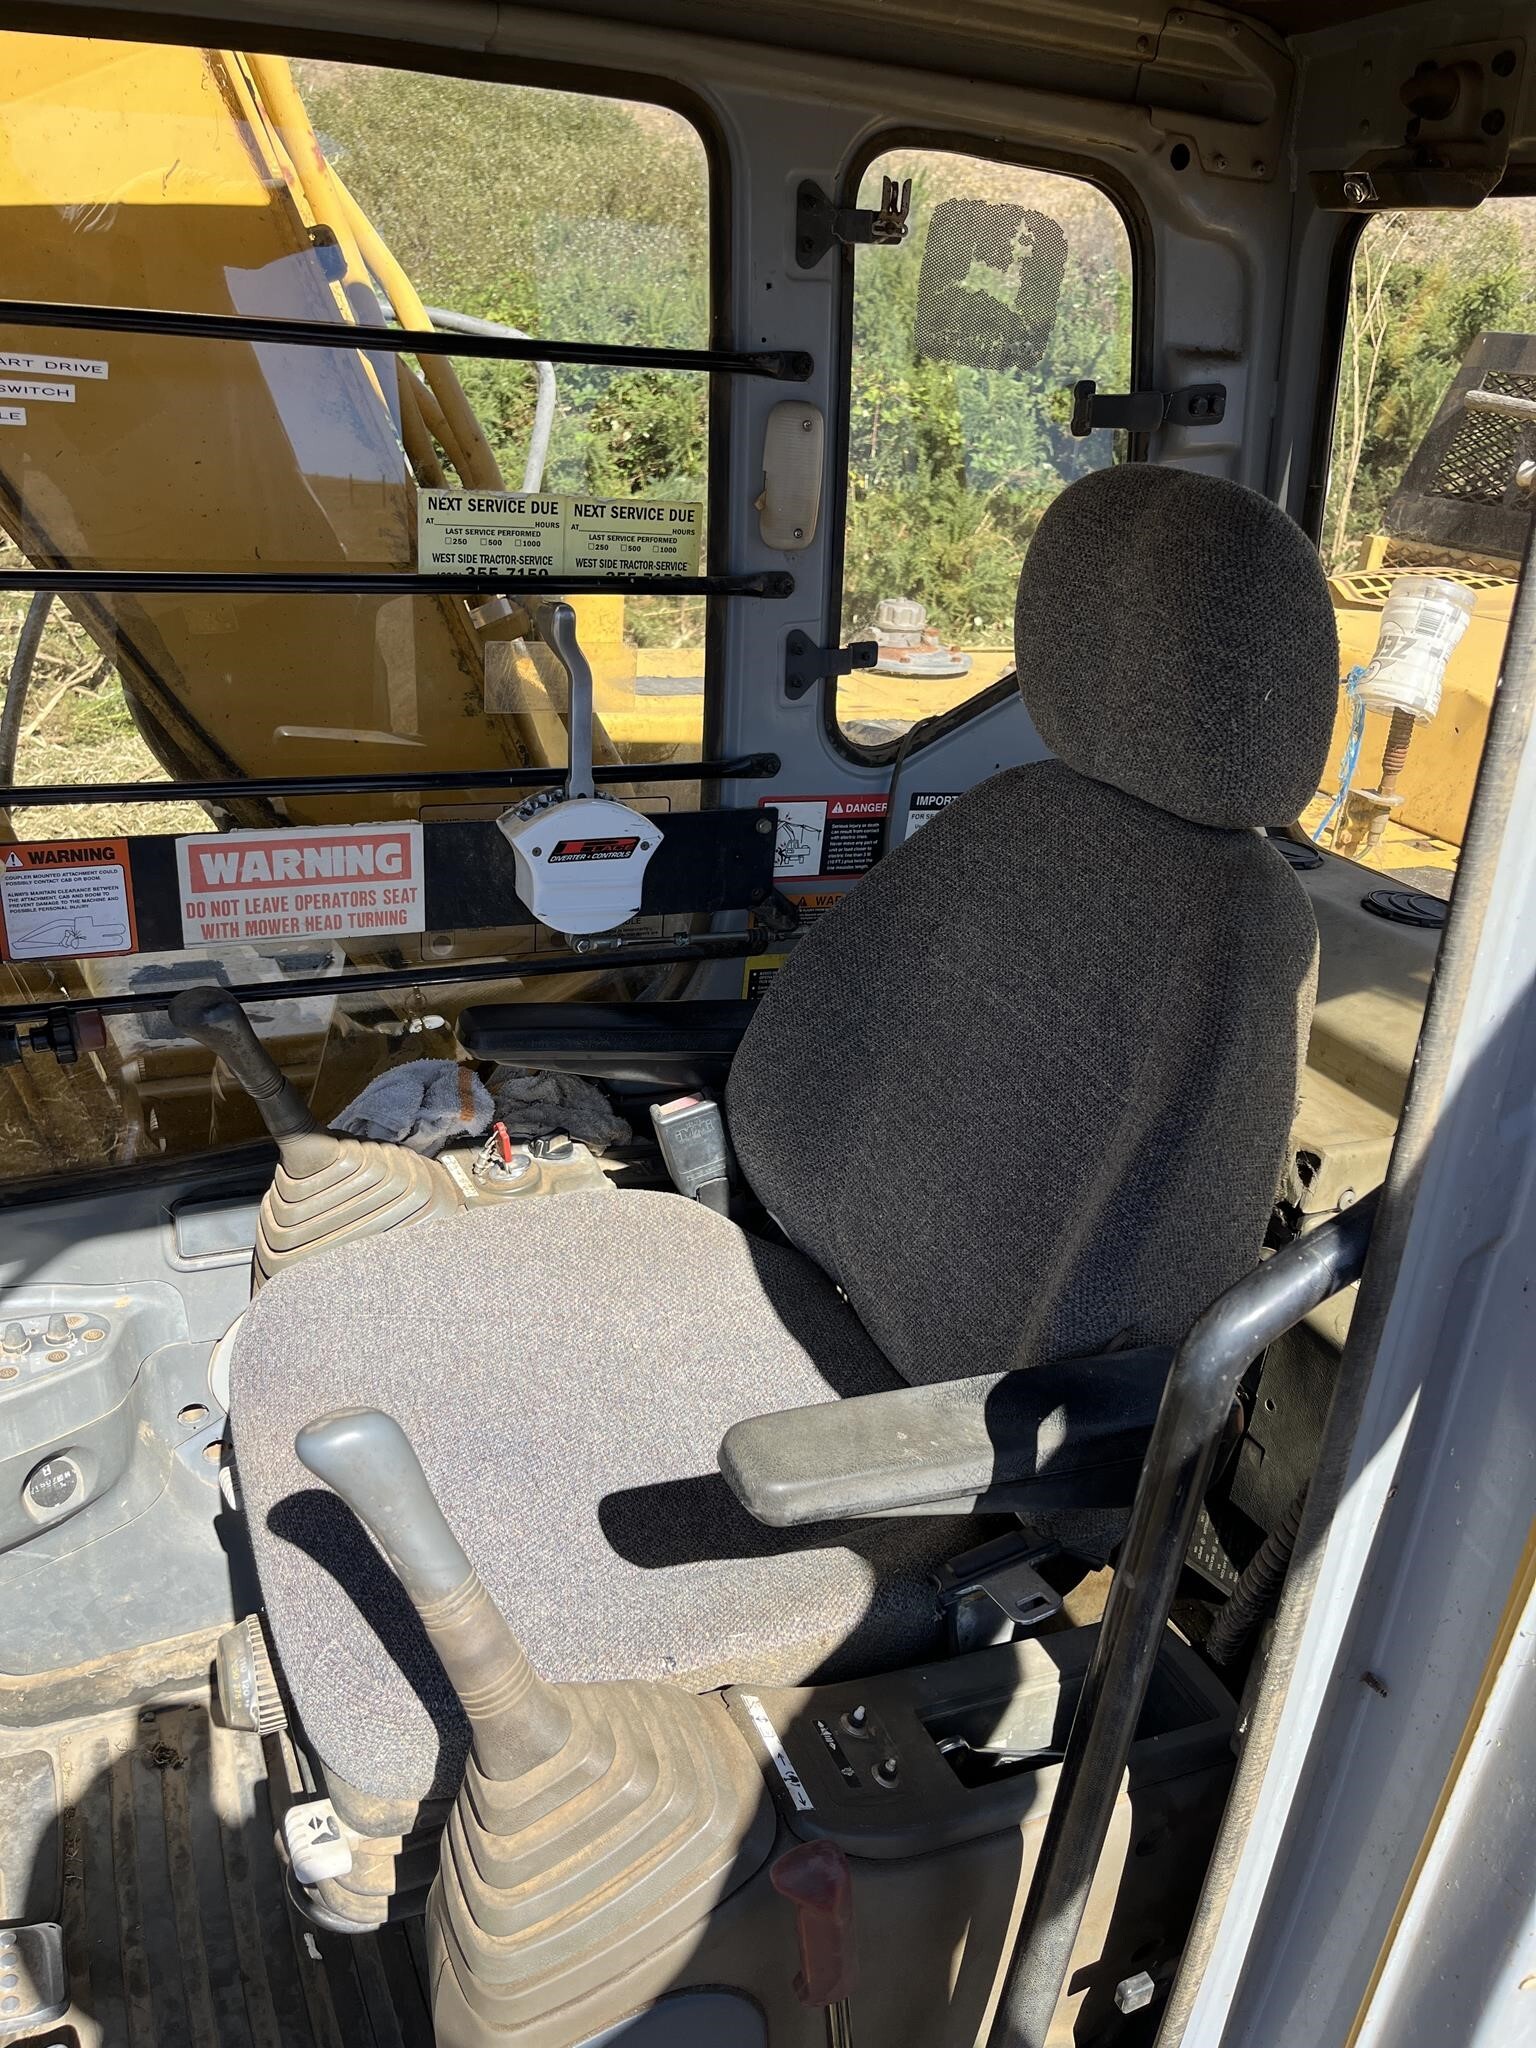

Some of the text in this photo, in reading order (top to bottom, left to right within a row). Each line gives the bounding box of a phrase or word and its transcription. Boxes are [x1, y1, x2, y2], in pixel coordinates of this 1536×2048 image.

[45, 361, 103, 374] DRIVE
[0, 384, 70, 398] SWITCH
[428, 496, 559, 515] NEXT SERVICE DUE
[574, 503, 695, 522] NEXT SERVICE DUE
[425, 517, 560, 529] AT HOURS
[571, 523, 695, 536] AT HOURS
[637, 536, 677, 544] PERFORMED
[432, 552, 553, 565] WEST SIDE TRACTOR-SERVICE
[576, 558, 688, 571] WEST SIDE TRACTOR-SERVICE
[27, 847, 116, 865] WARNING
[550, 854, 586, 863] DIVERTER
[591, 851, 632, 860] CONTROLS
[200, 842, 403, 886] WARNING
[38, 905, 69, 913] PERSONAL
[186, 887, 418, 919] DO NOT LEAVE OPERATORS SEAT
[200, 909, 408, 941] WITH MOWER HEAD TURNING
